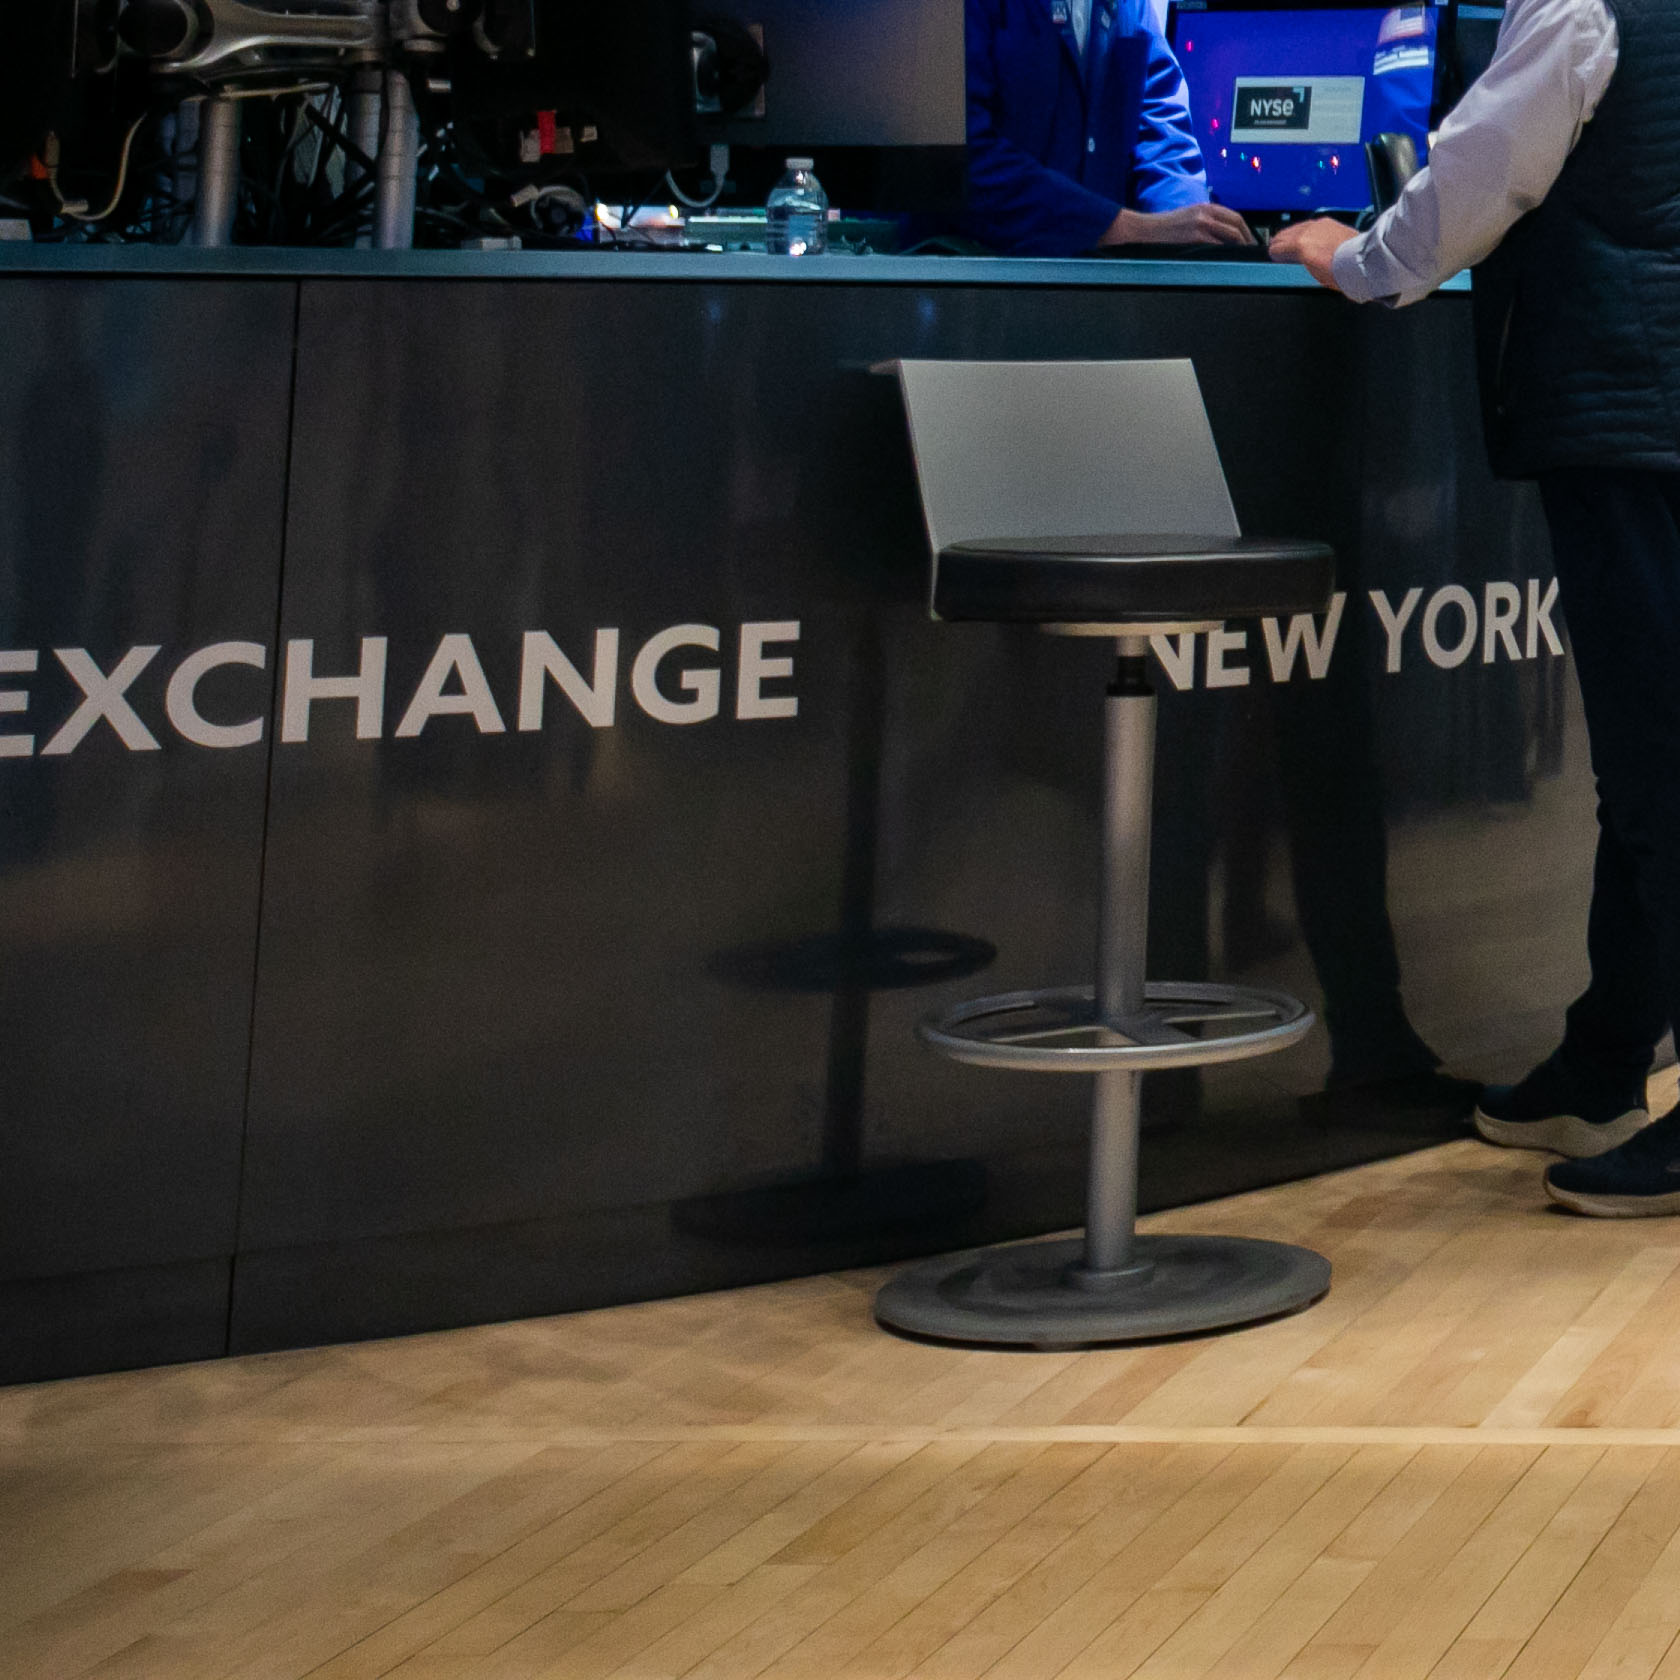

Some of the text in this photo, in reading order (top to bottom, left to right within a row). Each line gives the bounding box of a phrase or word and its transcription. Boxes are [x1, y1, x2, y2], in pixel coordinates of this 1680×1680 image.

[0, 619, 801, 759] EXCHANGE
[1149, 575, 1566, 692] NEW YORK
